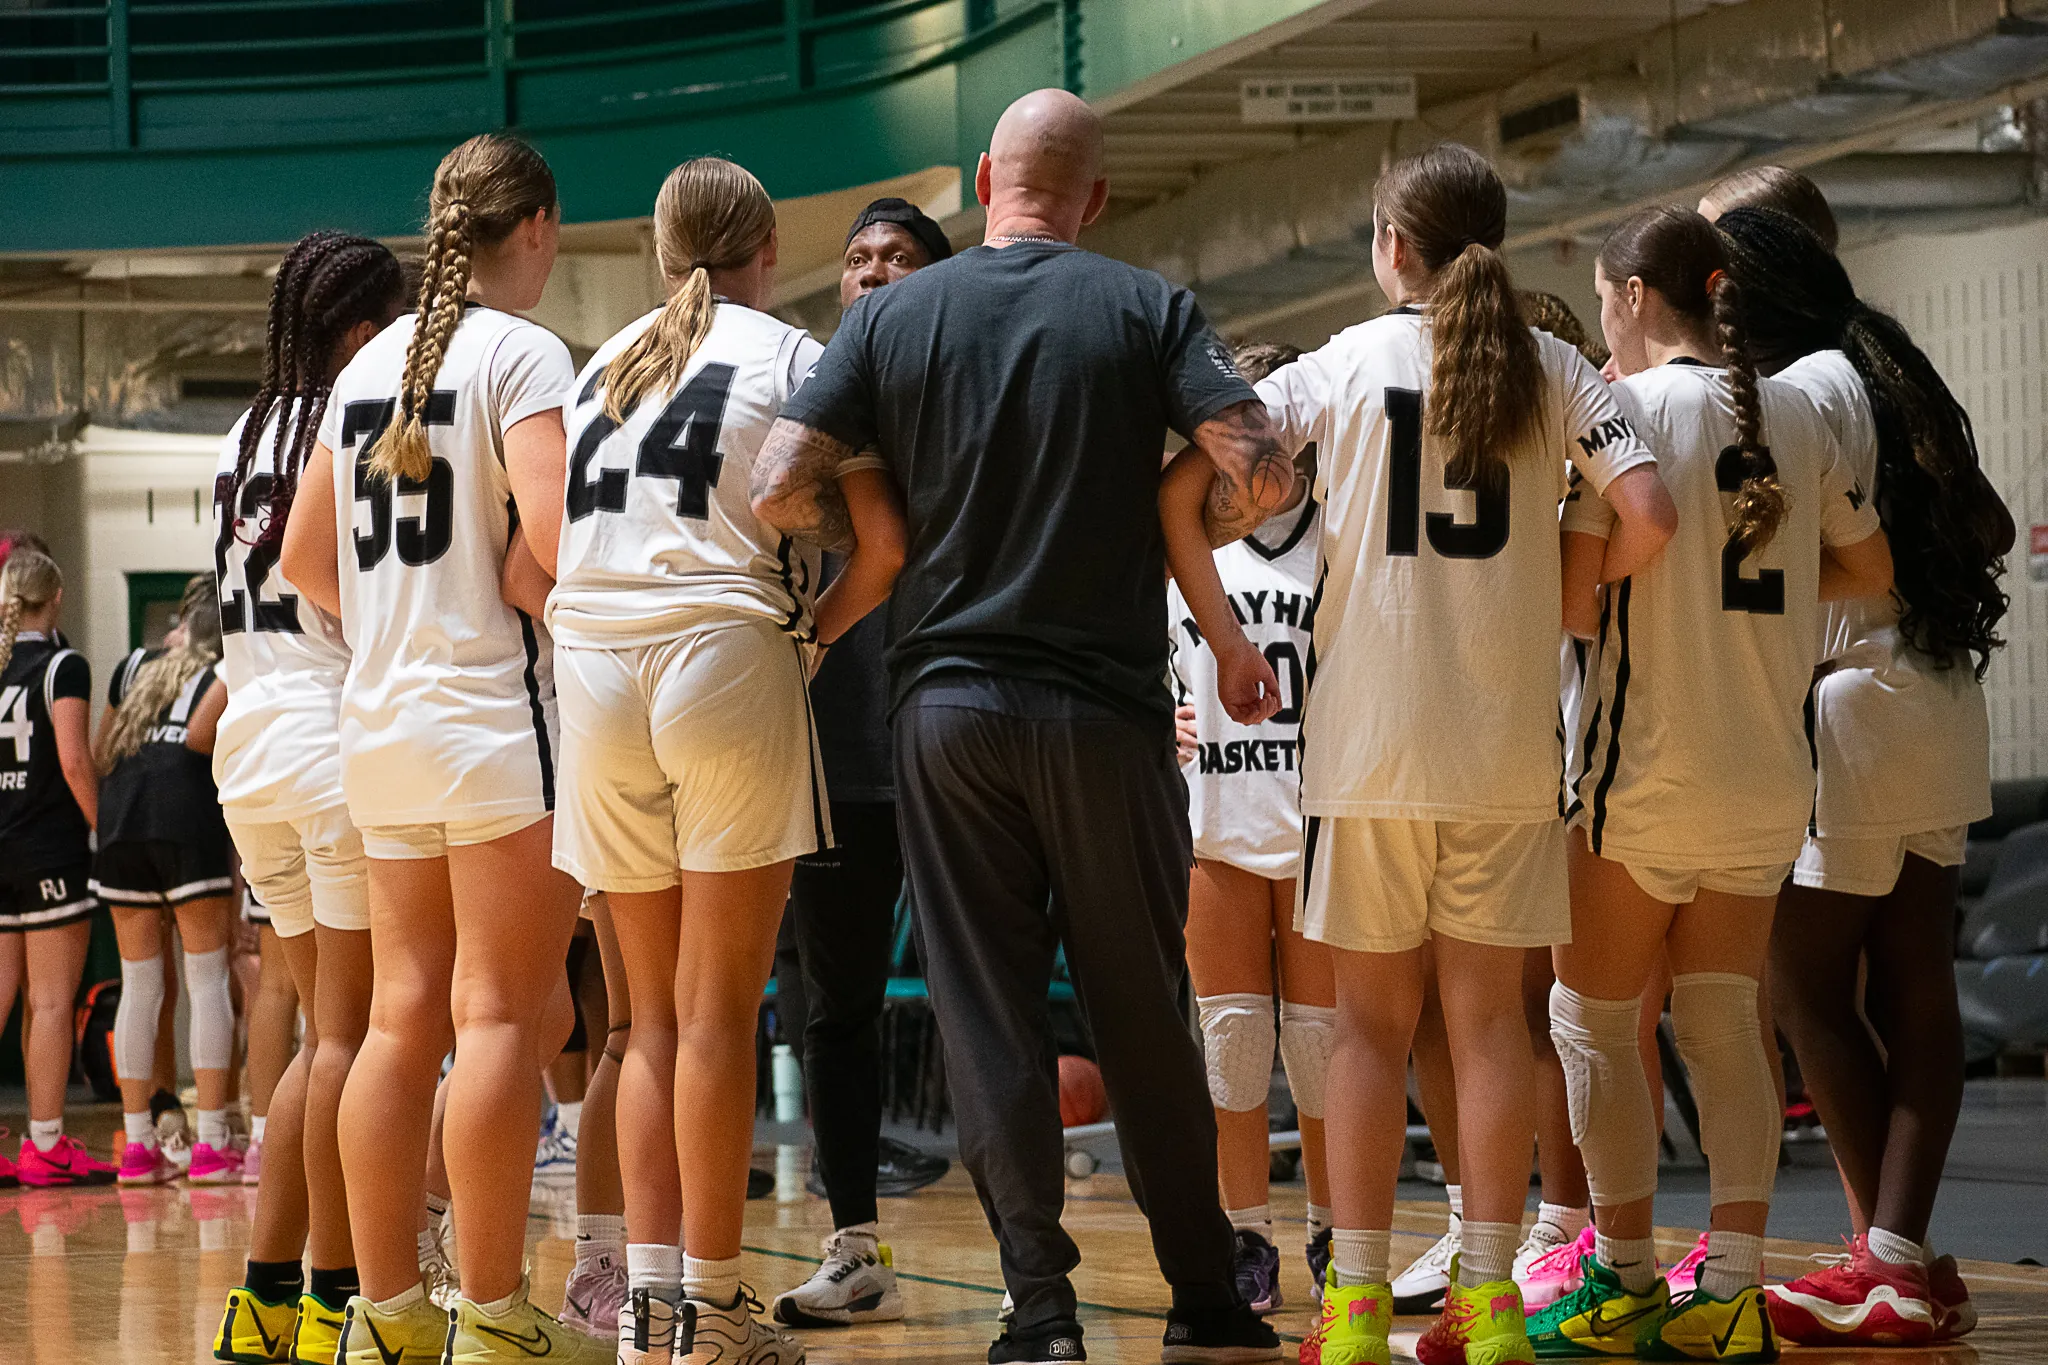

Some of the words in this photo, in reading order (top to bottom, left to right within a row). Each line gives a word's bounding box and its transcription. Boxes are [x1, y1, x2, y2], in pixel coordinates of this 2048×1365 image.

[342, 389, 457, 572] 35
[566, 361, 738, 524] 24
[1384, 386, 1511, 559] 13
[1577, 417, 1637, 458] MAY
[214, 472, 305, 636] 22
[1715, 445, 1785, 615] 2
[1253, 641, 1304, 725] 0
